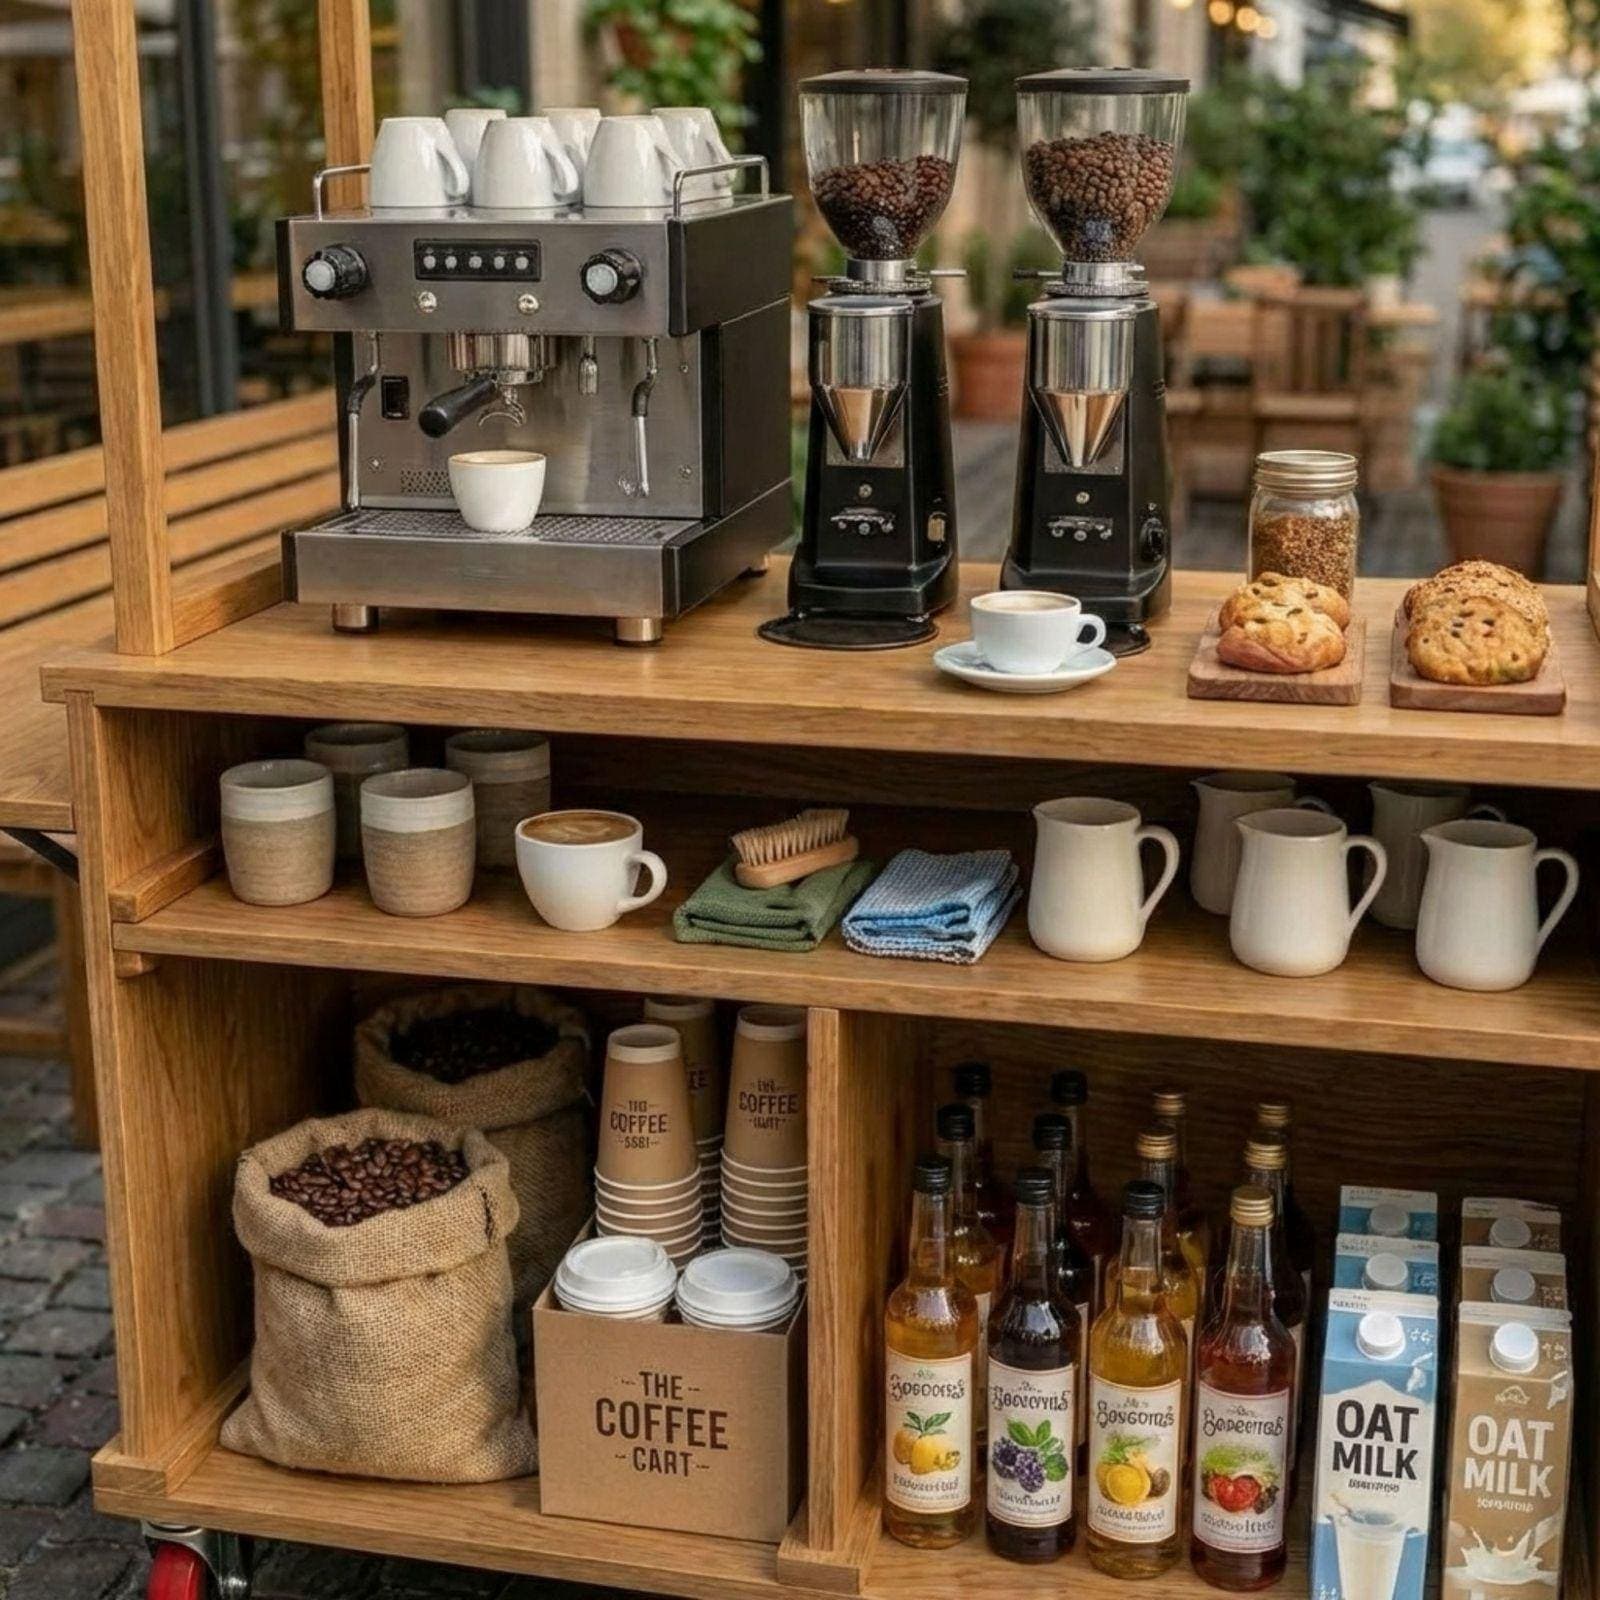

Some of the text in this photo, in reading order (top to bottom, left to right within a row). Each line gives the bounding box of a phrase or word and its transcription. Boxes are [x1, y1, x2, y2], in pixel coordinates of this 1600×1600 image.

[739, 1091, 799, 1115] COFFEE
[638, 1371, 684, 1400] THE
[595, 1397, 729, 1450] COFFEE
[1336, 1399, 1420, 1444] OAT
[1467, 1414, 1555, 1462] OAT
[632, 1446, 693, 1477] CART
[1331, 1441, 1418, 1480] MILK
[1463, 1457, 1555, 1498] MILK
